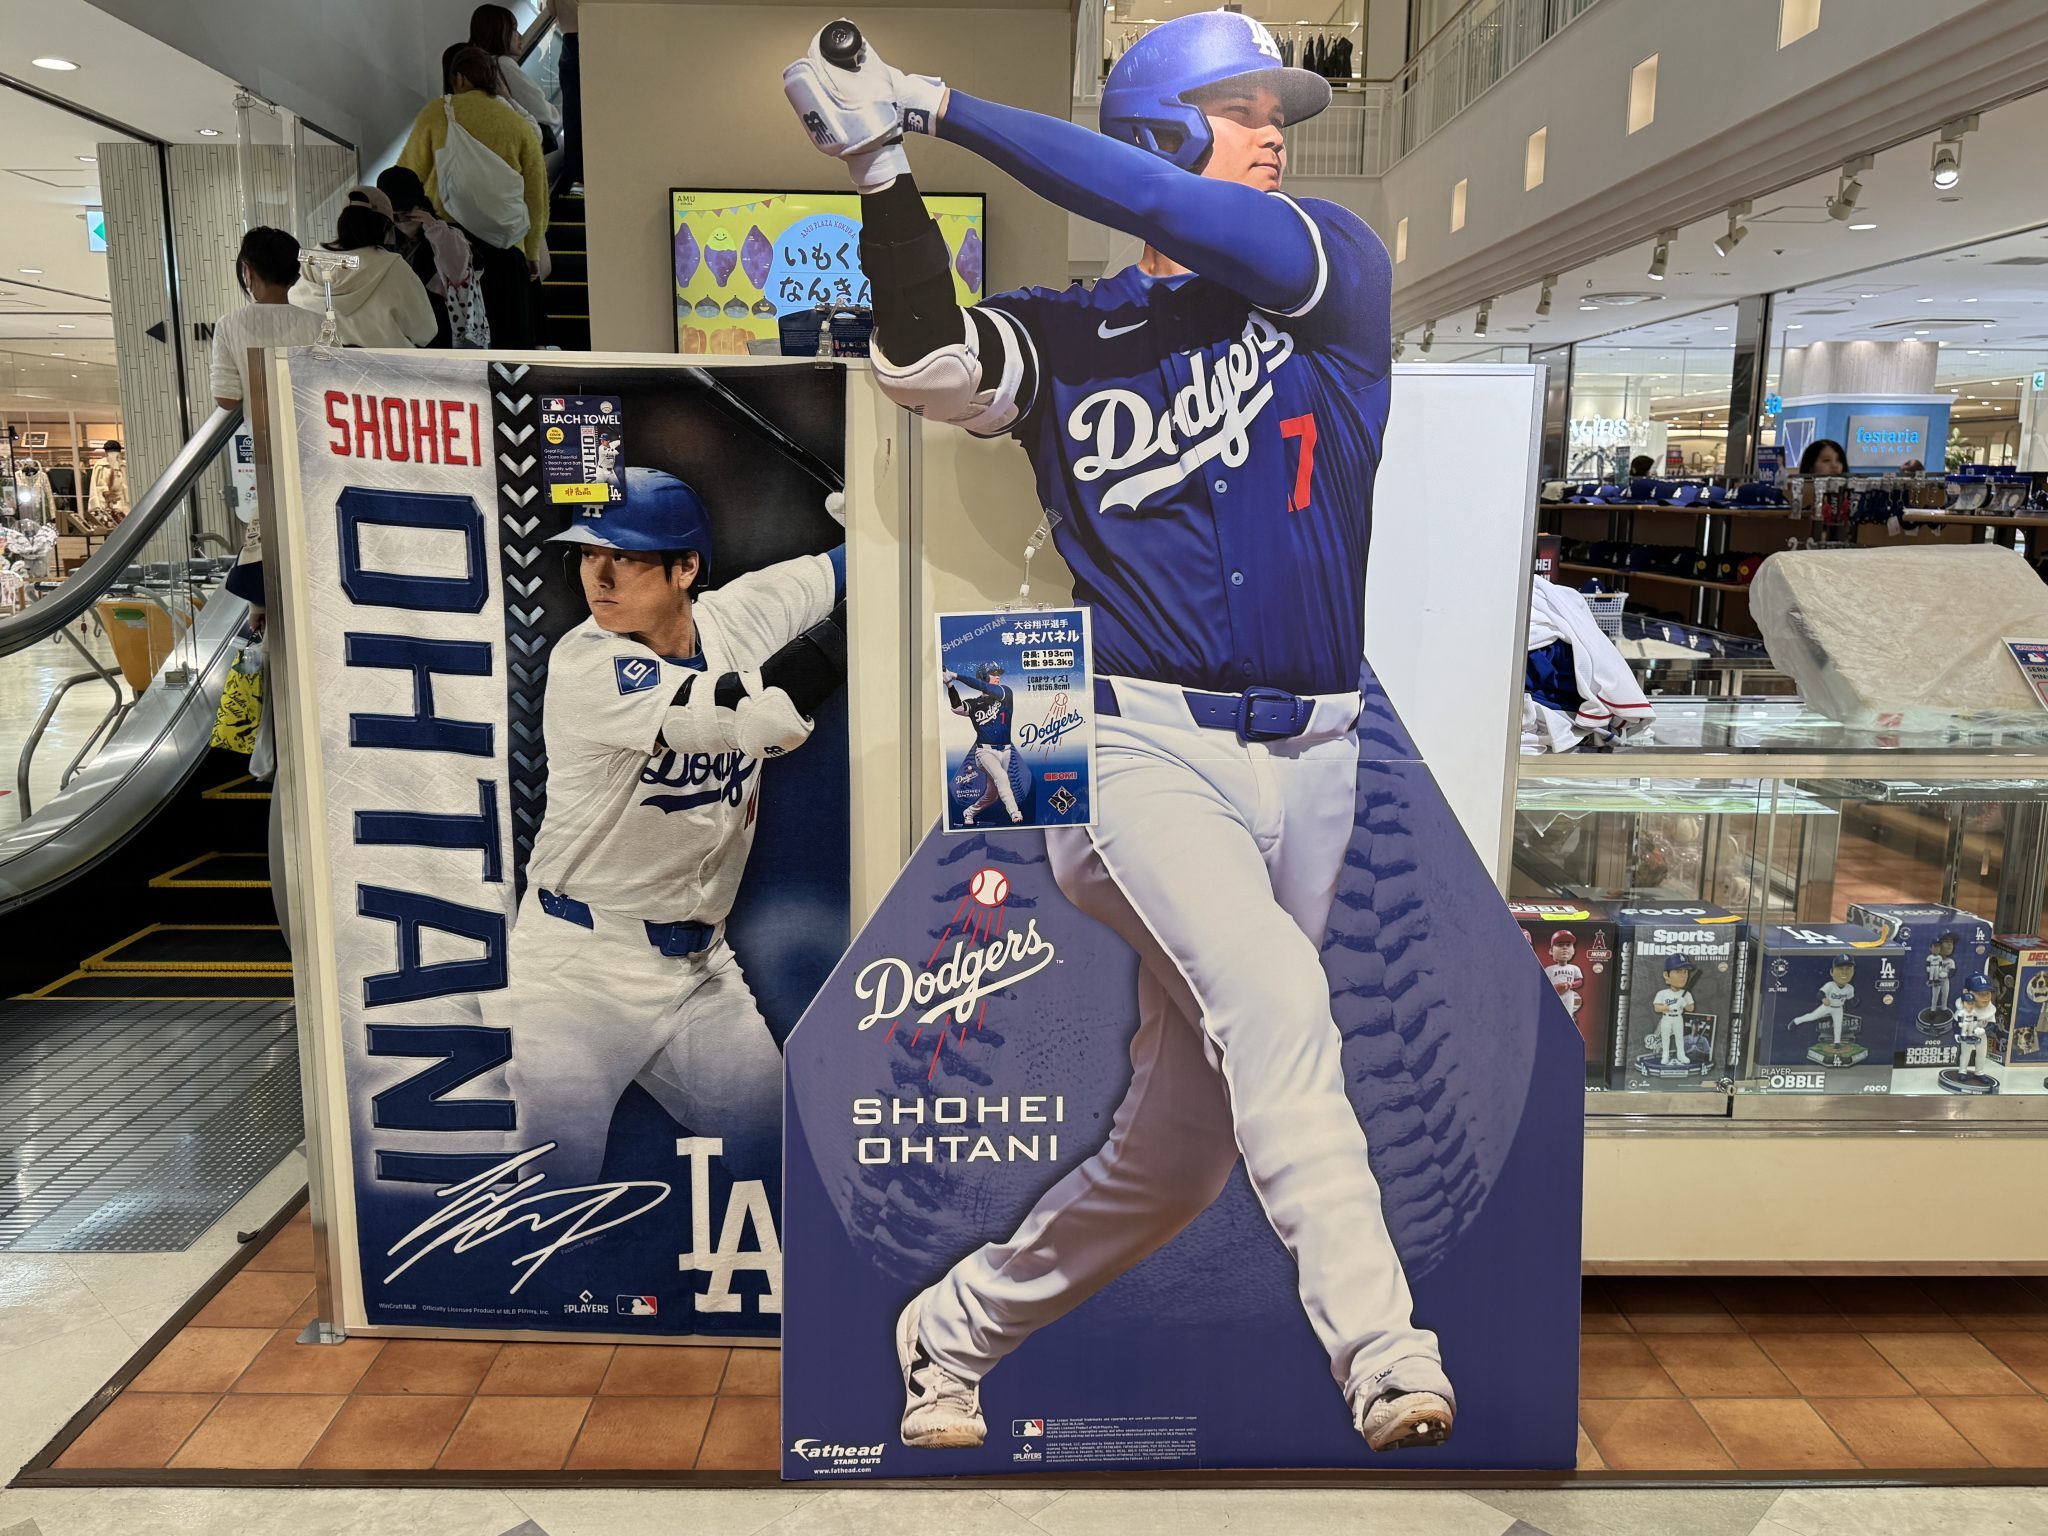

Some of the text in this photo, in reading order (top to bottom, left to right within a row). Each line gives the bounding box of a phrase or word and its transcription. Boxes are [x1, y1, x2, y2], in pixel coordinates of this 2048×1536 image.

[677, 195, 696, 203] AMU
[800, 220, 856, 240] AMU PLAZA KOKURA
[542, 414, 621, 425] BEACH TOWEL
[1068, 311, 1294, 513] Dodgers
[324, 389, 482, 467] SHOHEI
[1856, 427, 1920, 444] festaria
[582, 436, 597, 484] OHTAN
[609, 484, 622, 501] LA
[1014, 618, 1069, 630] 大谷翔平選手
[942, 616, 1007, 652] SHOHEI OHTANI
[1001, 630, 1080, 646] 等身大パネル
[1042, 650, 1073, 658] 193cm
[1042, 658, 1074, 668] 95.3kg
[1019, 708, 1085, 748] Dodgers
[336, 485, 519, 1185] OHTANI
[1653, 929, 1715, 943] Sports
[1776, 926, 1845, 944] LA
[1636, 941, 1730, 956] Illustrated
[854, 918, 1054, 1031] Dodgers
[1880, 958, 1896, 978] LA
[1906, 1047, 1951, 1056] BOBBLE
[852, 1096, 1064, 1125] SHOHEI
[858, 1135, 1058, 1165] OHTANI
[676, 1136, 781, 1314] LA
[568, 1304, 609, 1314] PLAYERS
